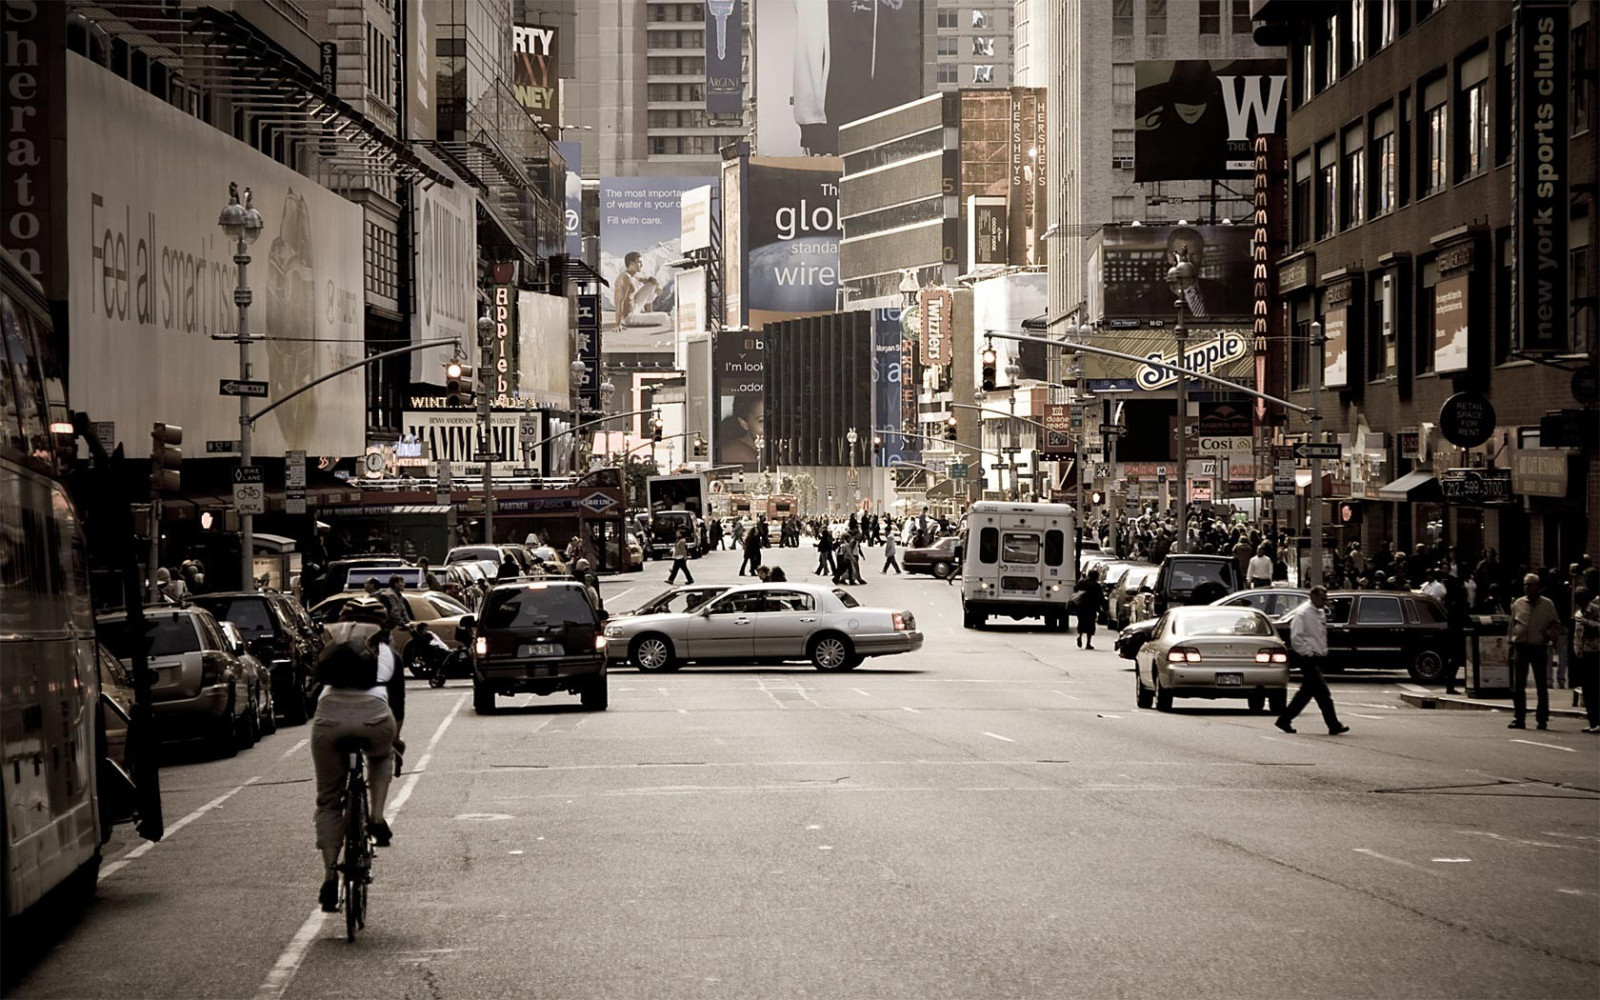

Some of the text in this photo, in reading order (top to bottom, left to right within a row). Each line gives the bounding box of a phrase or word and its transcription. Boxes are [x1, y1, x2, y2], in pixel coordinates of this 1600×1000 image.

[708, 76, 740, 87] ARGENT
[1013, 101, 1021, 185] HERSHEYS
[1037, 103, 1046, 186] HERSHEYS
[1533, 16, 1559, 339] new york sports clubs
[606, 189, 622, 197] The
[820, 183, 840, 196] Th
[654, 201, 673, 209] your
[607, 216, 619, 224] Fill
[621, 216, 639, 224] with
[91, 192, 130, 321] Feel
[136, 212, 156, 325] all
[162, 236, 207, 335] smart
[928, 296, 944, 359] Twizzlers
[725, 362, 742, 371] I'm
[1456, 402, 1484, 410] RETAIL
[1456, 411, 1483, 419] SPACE
[521, 427, 535, 435] 30
[499, 501, 528, 511] PARTNER
